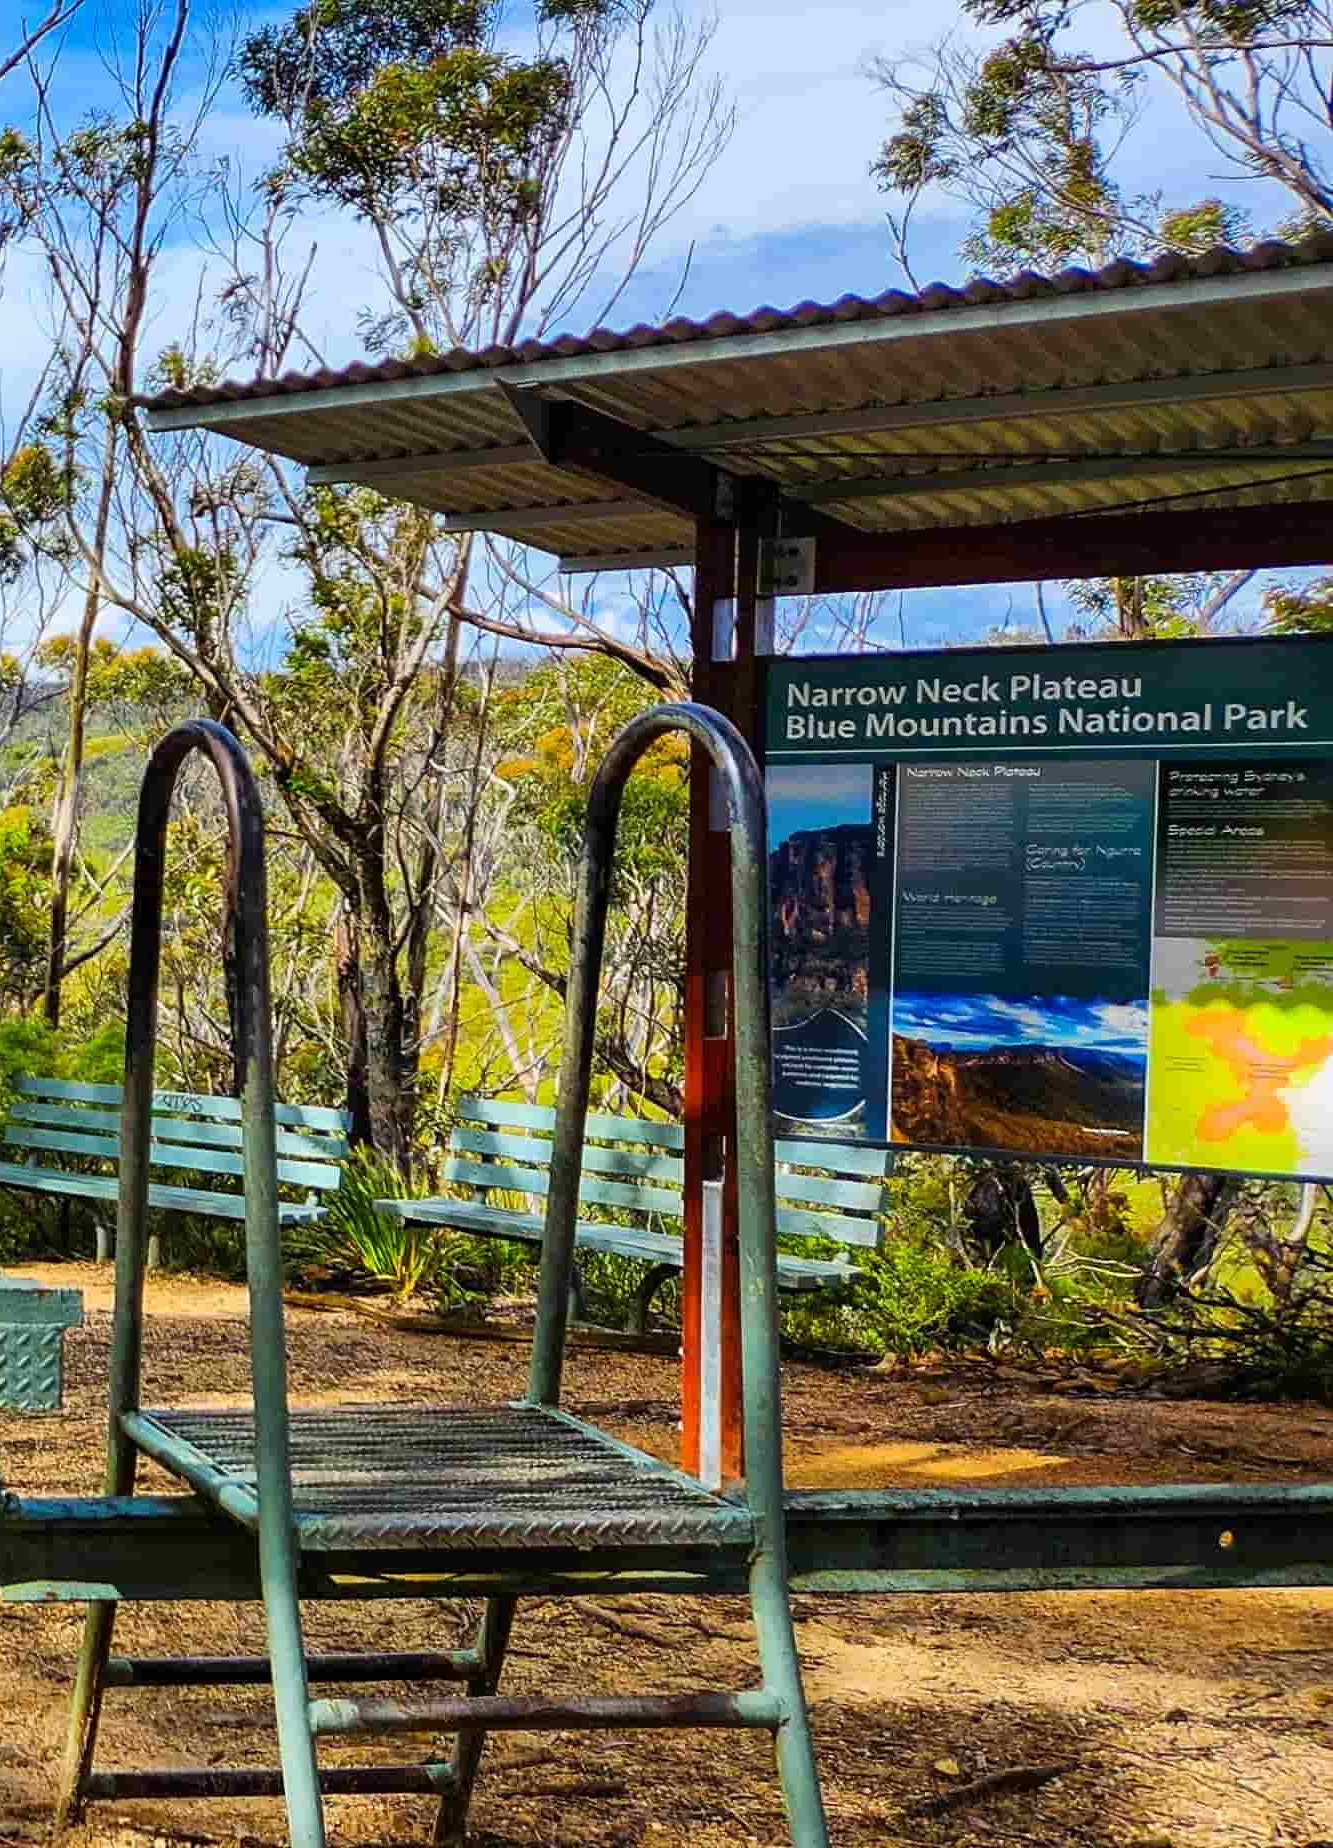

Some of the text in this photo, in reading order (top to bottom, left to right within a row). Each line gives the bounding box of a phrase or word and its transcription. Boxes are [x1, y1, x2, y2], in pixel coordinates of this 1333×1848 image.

[787, 673, 1142, 707] Narrow Neck Plateau
[786, 701, 1309, 740] Blue Mountains National Park
[907, 766, 1041, 777] Narrow Neck Plateau
